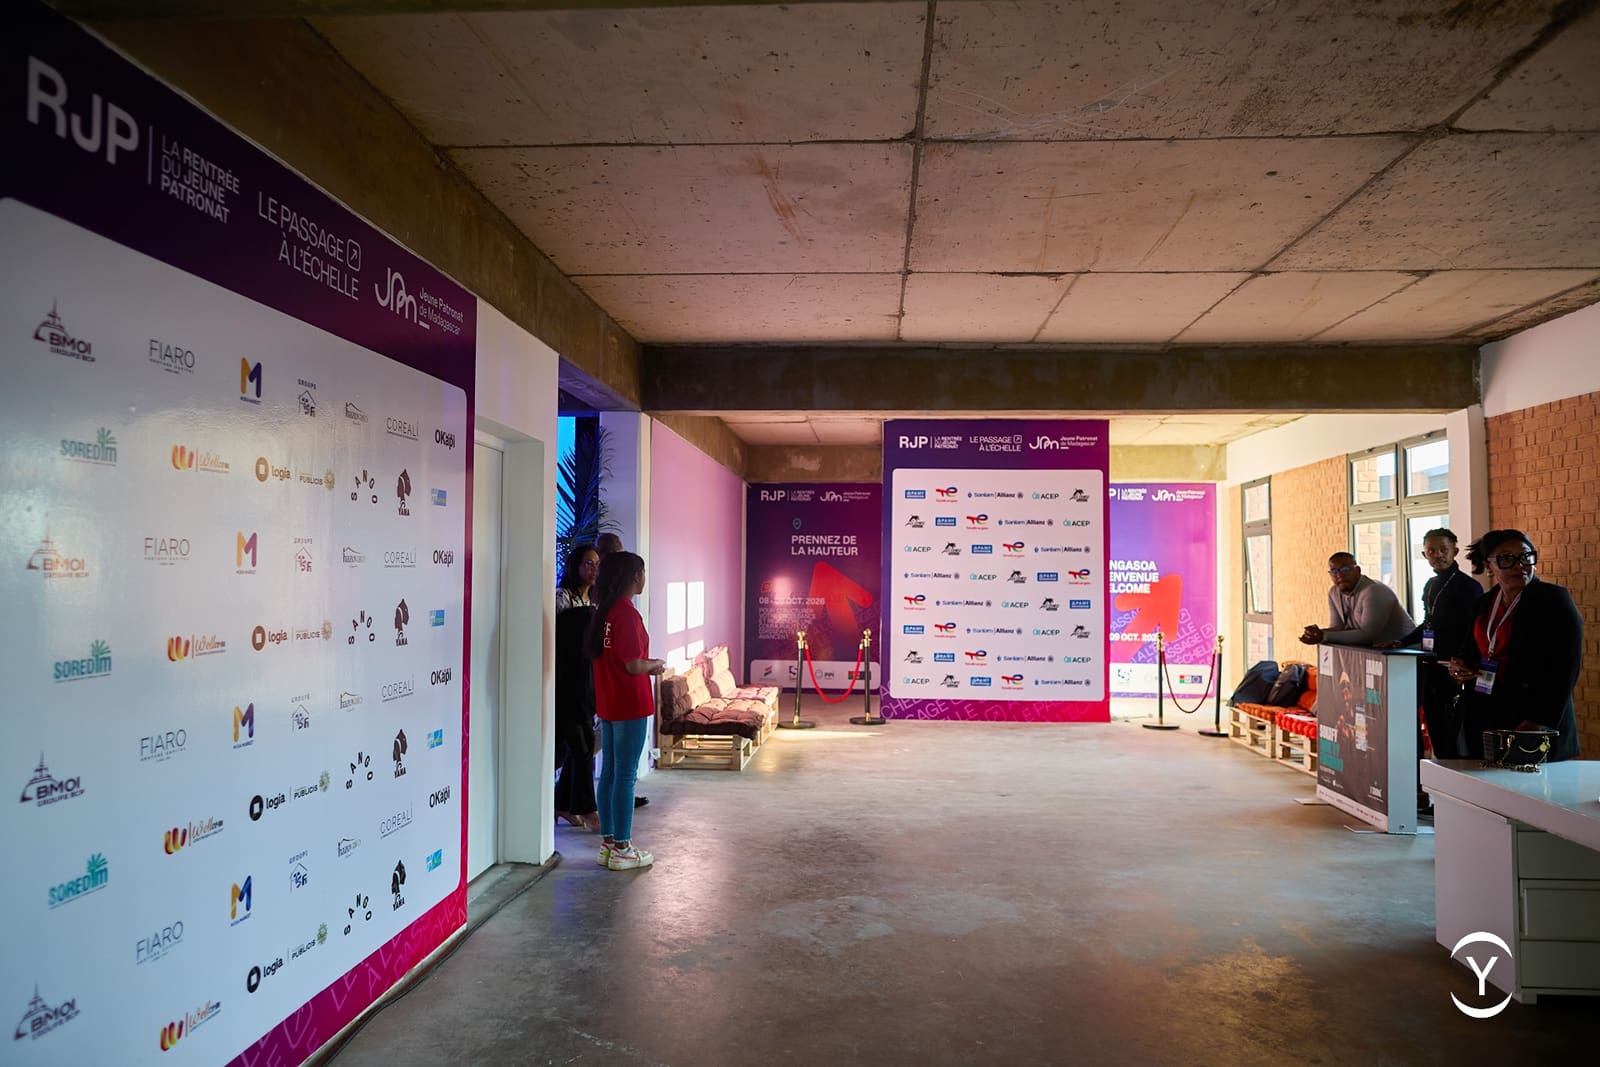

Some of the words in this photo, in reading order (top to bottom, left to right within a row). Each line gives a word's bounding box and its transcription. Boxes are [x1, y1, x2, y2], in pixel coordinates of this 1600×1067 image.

[27, 55, 140, 165] RJP
[161, 134, 181, 160] LA
[183, 148, 241, 195] RENTRÉE
[161, 155, 181, 180] DU
[183, 168, 226, 205] JEUNE
[160, 174, 230, 224] PATRONAT
[258, 191, 278, 225] LE
[280, 204, 344, 263] PASSAGE
[278, 232, 291, 267] À
[293, 245, 360, 301] L'ÉCHELLE
[419, 287, 439, 307] Jeune
[438, 297, 464, 323] Patronat
[418, 304, 428, 318] de
[427, 308, 462, 336] Madagascar
[49, 332, 92, 355] BMOI
[149, 339, 196, 369] FIARO
[899, 435, 929, 449] RJP
[979, 443, 984, 451] À
[985, 443, 1021, 451] L'ÉCHELLE
[760, 490, 786, 501] RJP
[144, 537, 191, 557] FIARO
[791, 535, 840, 544] PRENNEZ
[843, 536, 856, 544] DE
[791, 546, 805, 556] LA
[808, 546, 858, 556] HAUTEUR
[42, 557, 85, 572] BMOI
[1142, 633, 1158, 641] 202
[140, 728, 187, 757] FIARO
[36, 776, 81, 800] BMOI
[265, 792, 286, 811] logia
[135, 920, 184, 961] FIARO
[263, 958, 284, 979] logia
[30, 998, 77, 1033] BMOI
